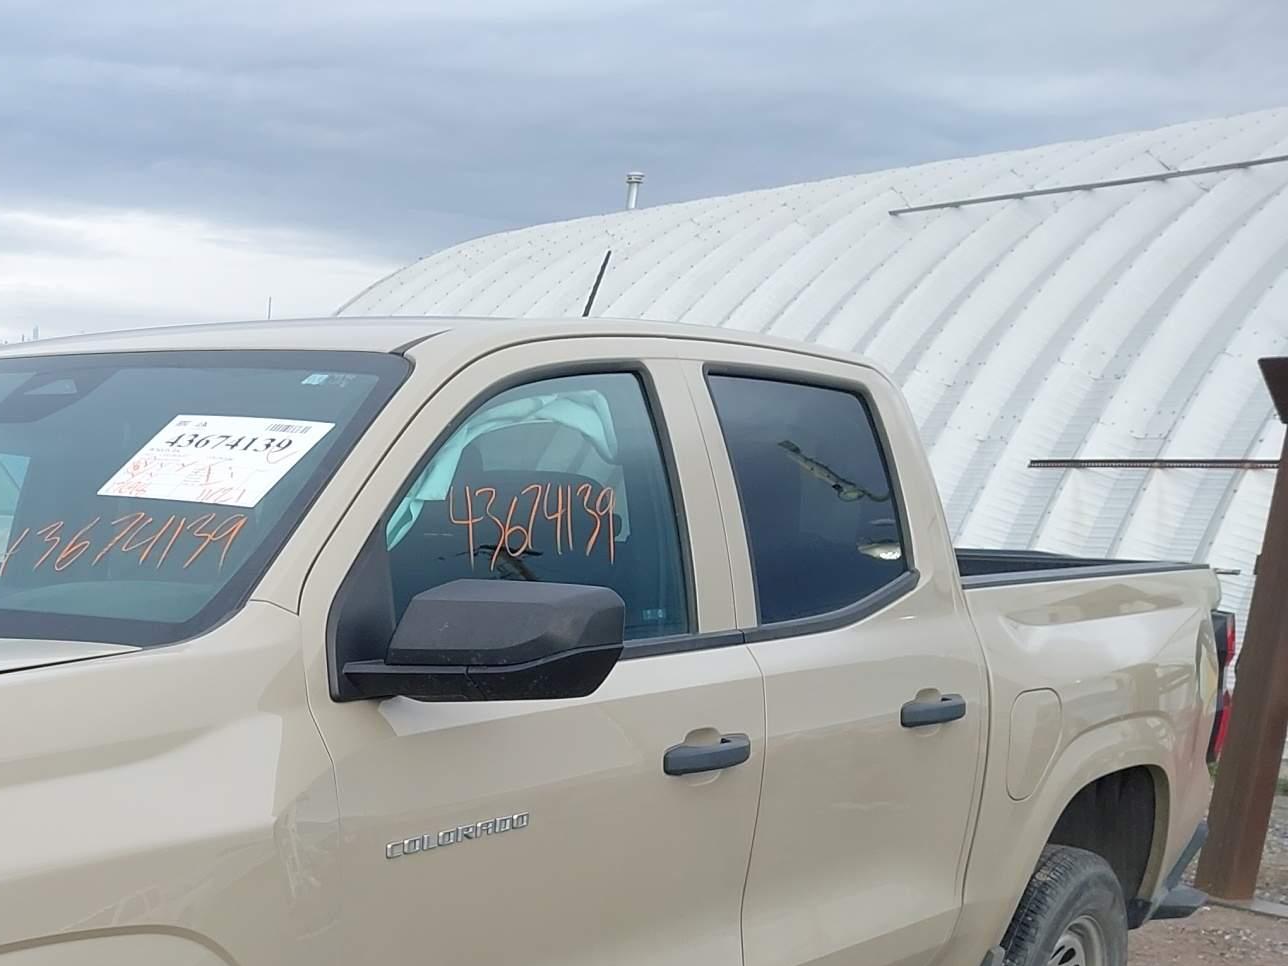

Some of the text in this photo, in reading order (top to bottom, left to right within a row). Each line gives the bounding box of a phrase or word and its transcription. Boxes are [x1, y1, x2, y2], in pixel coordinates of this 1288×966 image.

[164, 433, 293, 454] 43674139
[449, 483, 616, 572] 43674139
[386, 811, 529, 859] COLORADO
